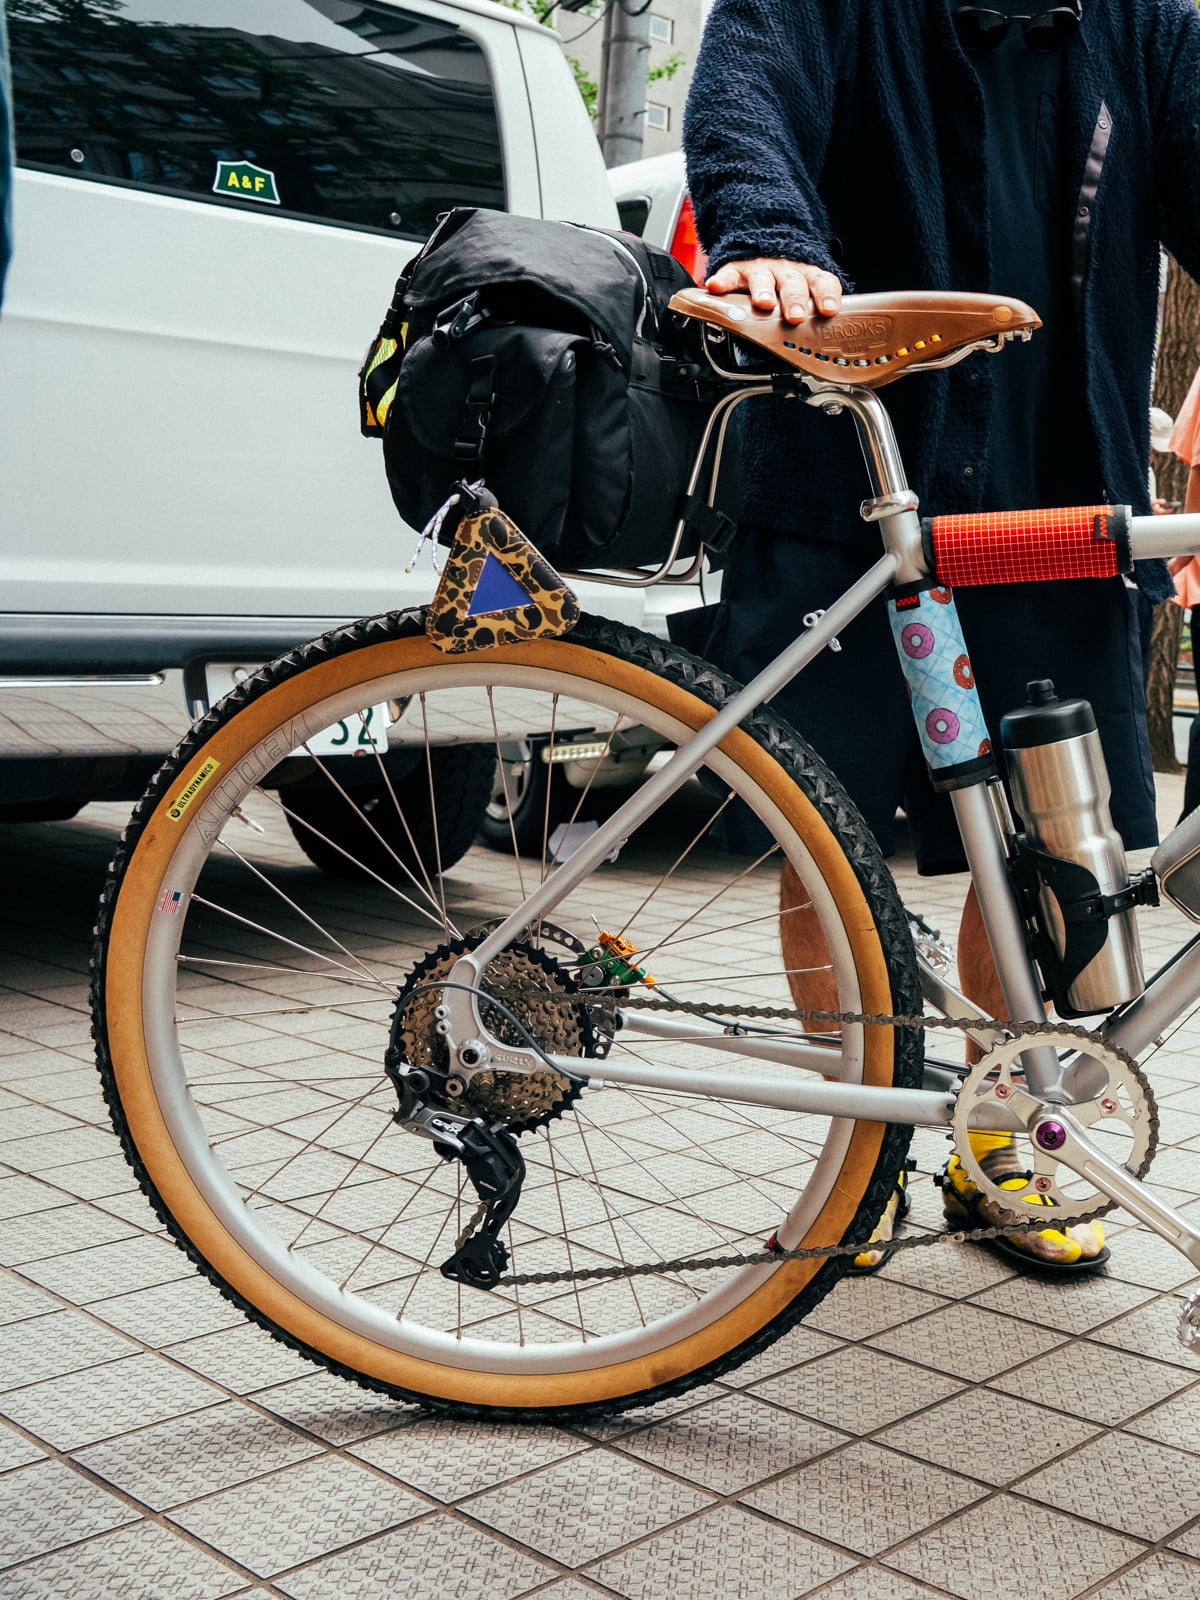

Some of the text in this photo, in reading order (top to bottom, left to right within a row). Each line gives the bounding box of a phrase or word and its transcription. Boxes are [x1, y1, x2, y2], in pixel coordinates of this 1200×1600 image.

[821, 321, 885, 339] BROOKS
[177, 763, 214, 809] ULTRADYNAMICO
[493, 1054, 532, 1067] SURLY
